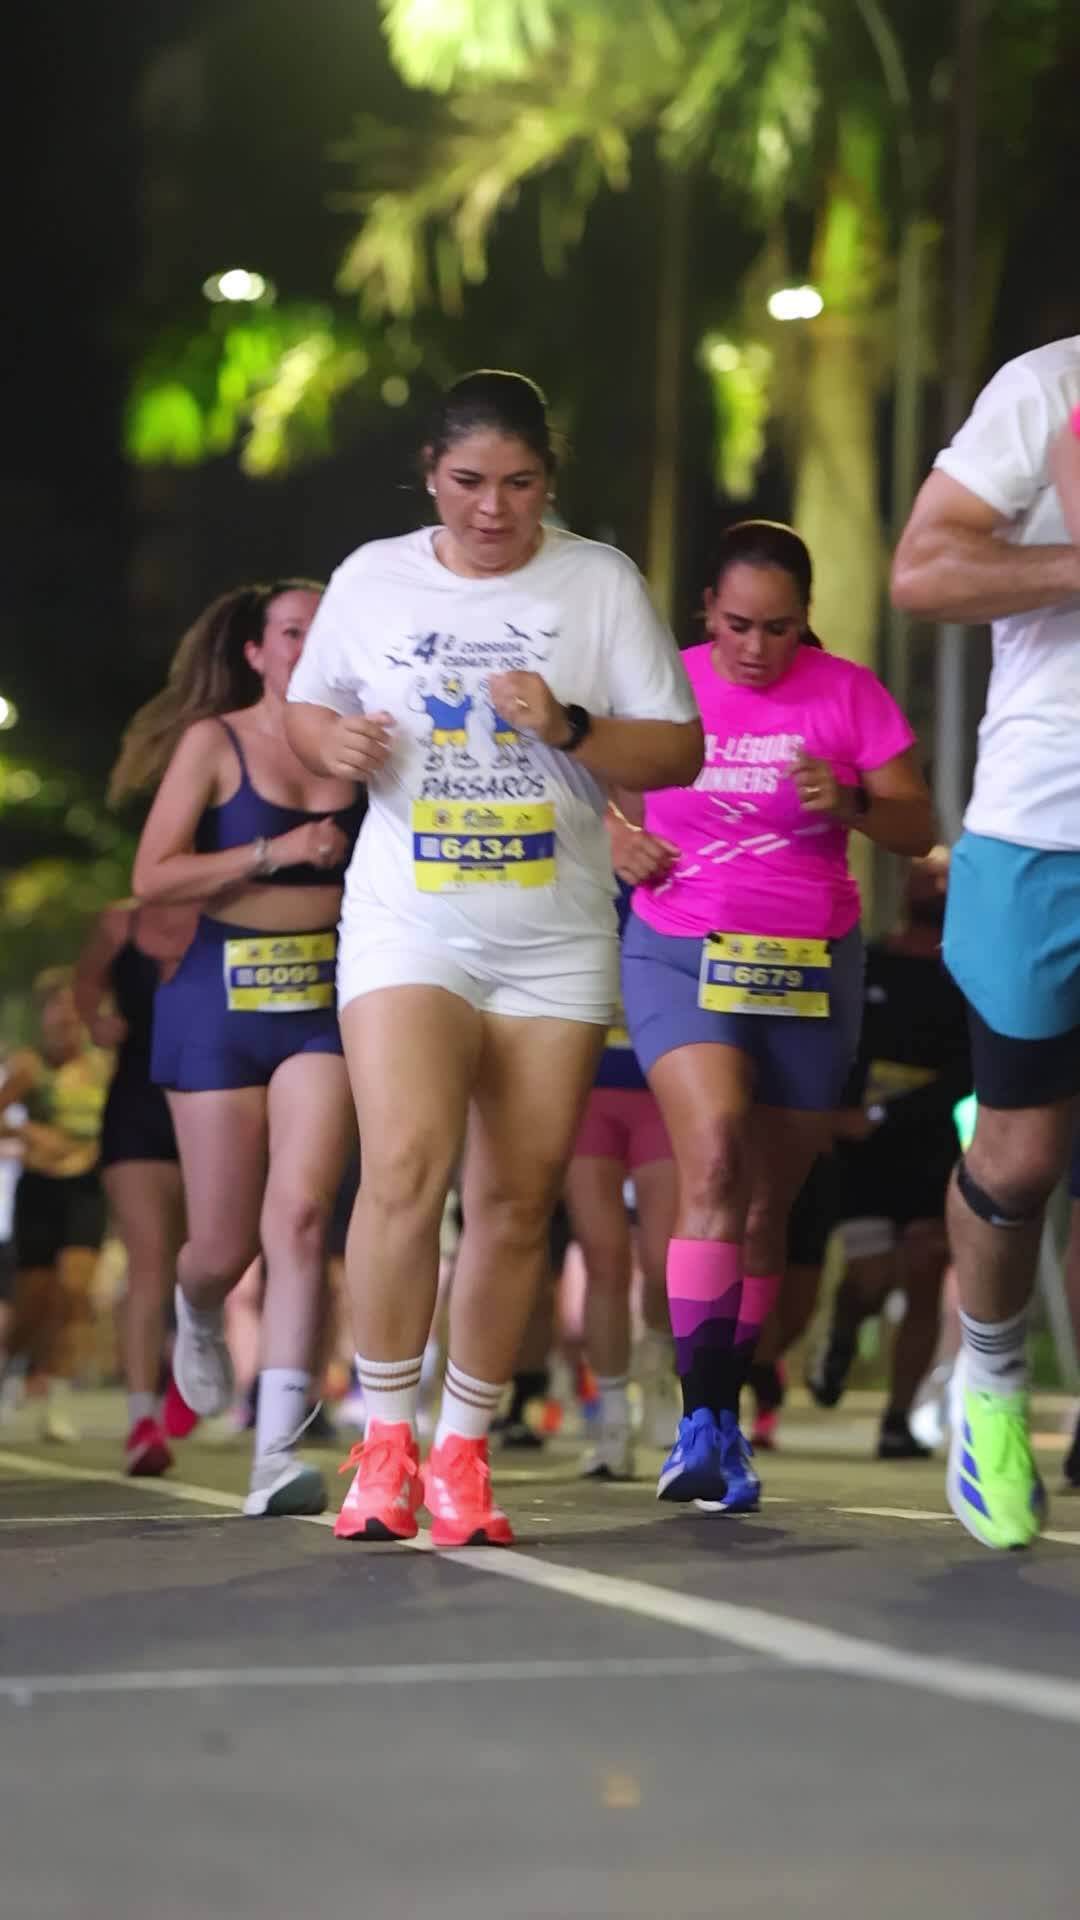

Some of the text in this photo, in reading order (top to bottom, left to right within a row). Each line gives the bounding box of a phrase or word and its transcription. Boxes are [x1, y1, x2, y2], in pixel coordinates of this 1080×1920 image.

[693, 766, 779, 793] UNNERS
[440, 837, 526, 860] 6434
[255, 965, 319, 986] 6099
[734, 965, 803, 988] 6679
